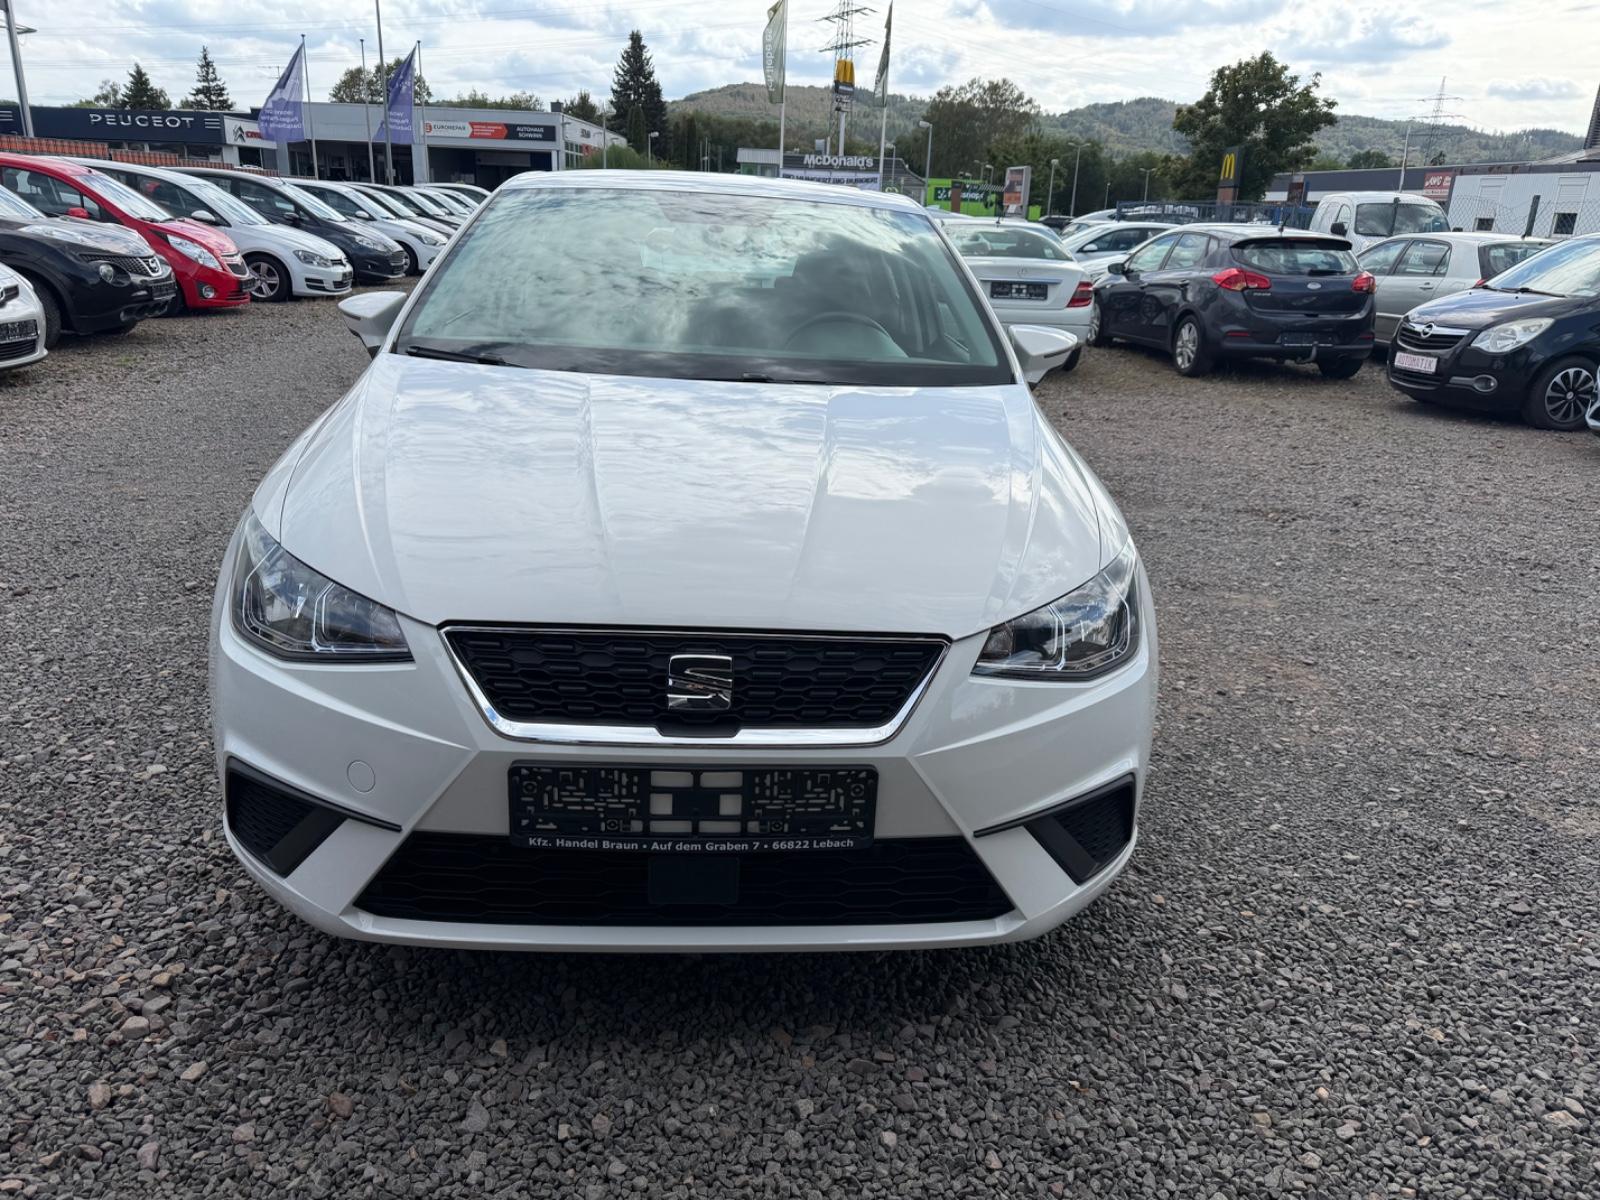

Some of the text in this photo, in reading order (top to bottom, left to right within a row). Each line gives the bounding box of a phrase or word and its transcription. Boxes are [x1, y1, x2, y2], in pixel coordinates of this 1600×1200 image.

[89, 113, 194, 129] PEUGEOT
[803, 154, 874, 168] McDonald's
[1397, 353, 1434, 370] AUTOMATIK
[528, 837, 854, 851] Kfz. Handel Braun Auf dem Graben 7 66822 Lebach
